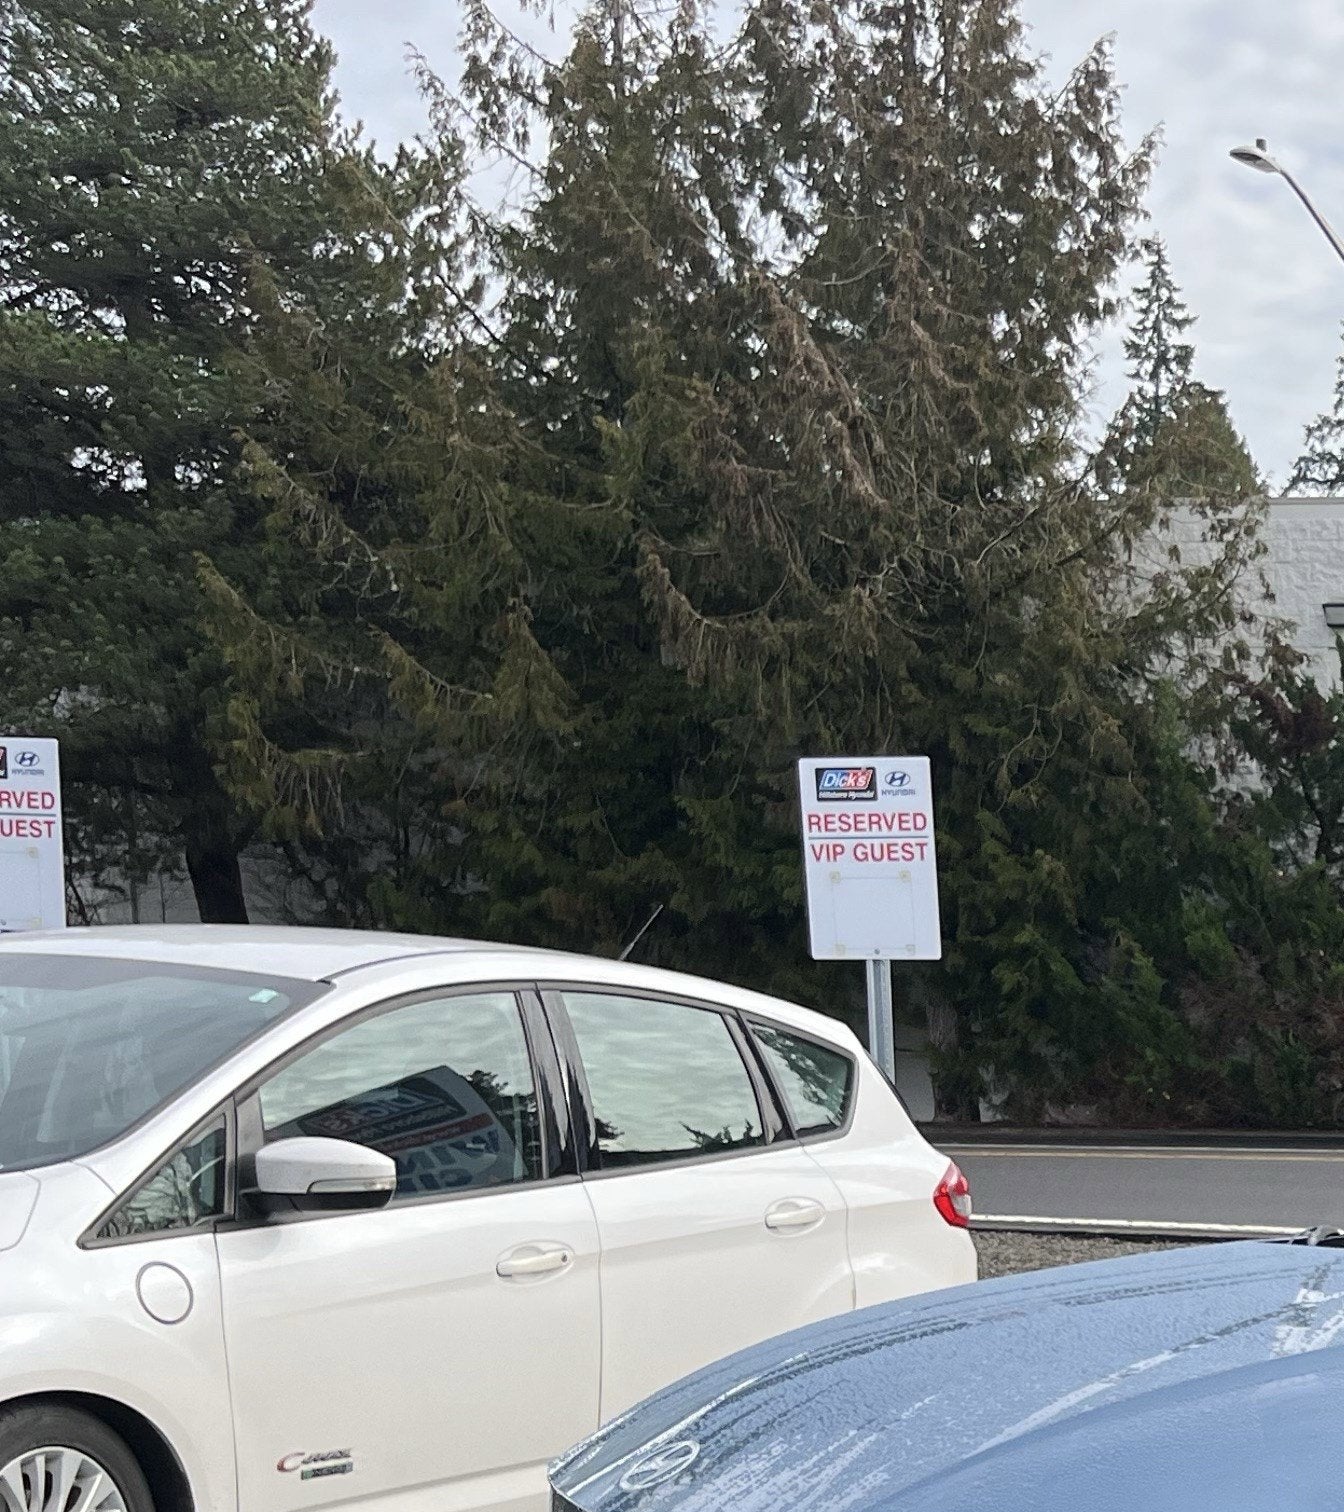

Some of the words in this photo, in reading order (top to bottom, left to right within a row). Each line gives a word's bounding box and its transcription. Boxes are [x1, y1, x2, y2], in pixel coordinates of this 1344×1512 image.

[808, 812, 928, 833] RESERVED
[810, 843, 846, 863] VIP
[853, 842, 928, 863] GUEST
